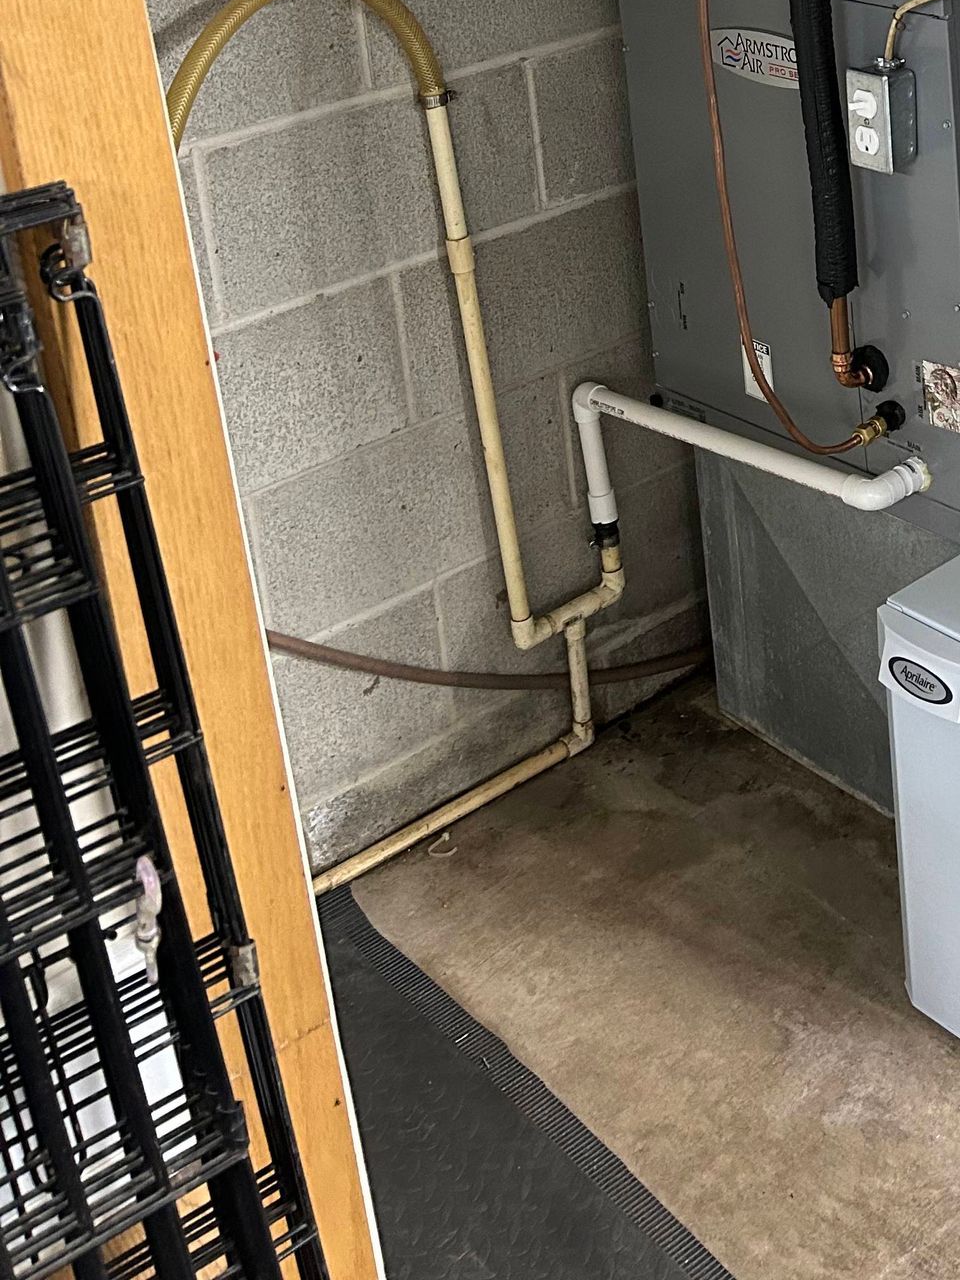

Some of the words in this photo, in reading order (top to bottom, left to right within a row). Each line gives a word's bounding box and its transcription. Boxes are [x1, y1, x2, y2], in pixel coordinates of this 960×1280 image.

[769, 66, 786, 76] PRO
[752, 341, 768, 354] TICE
[900, 665, 935, 693] Aprilaire
